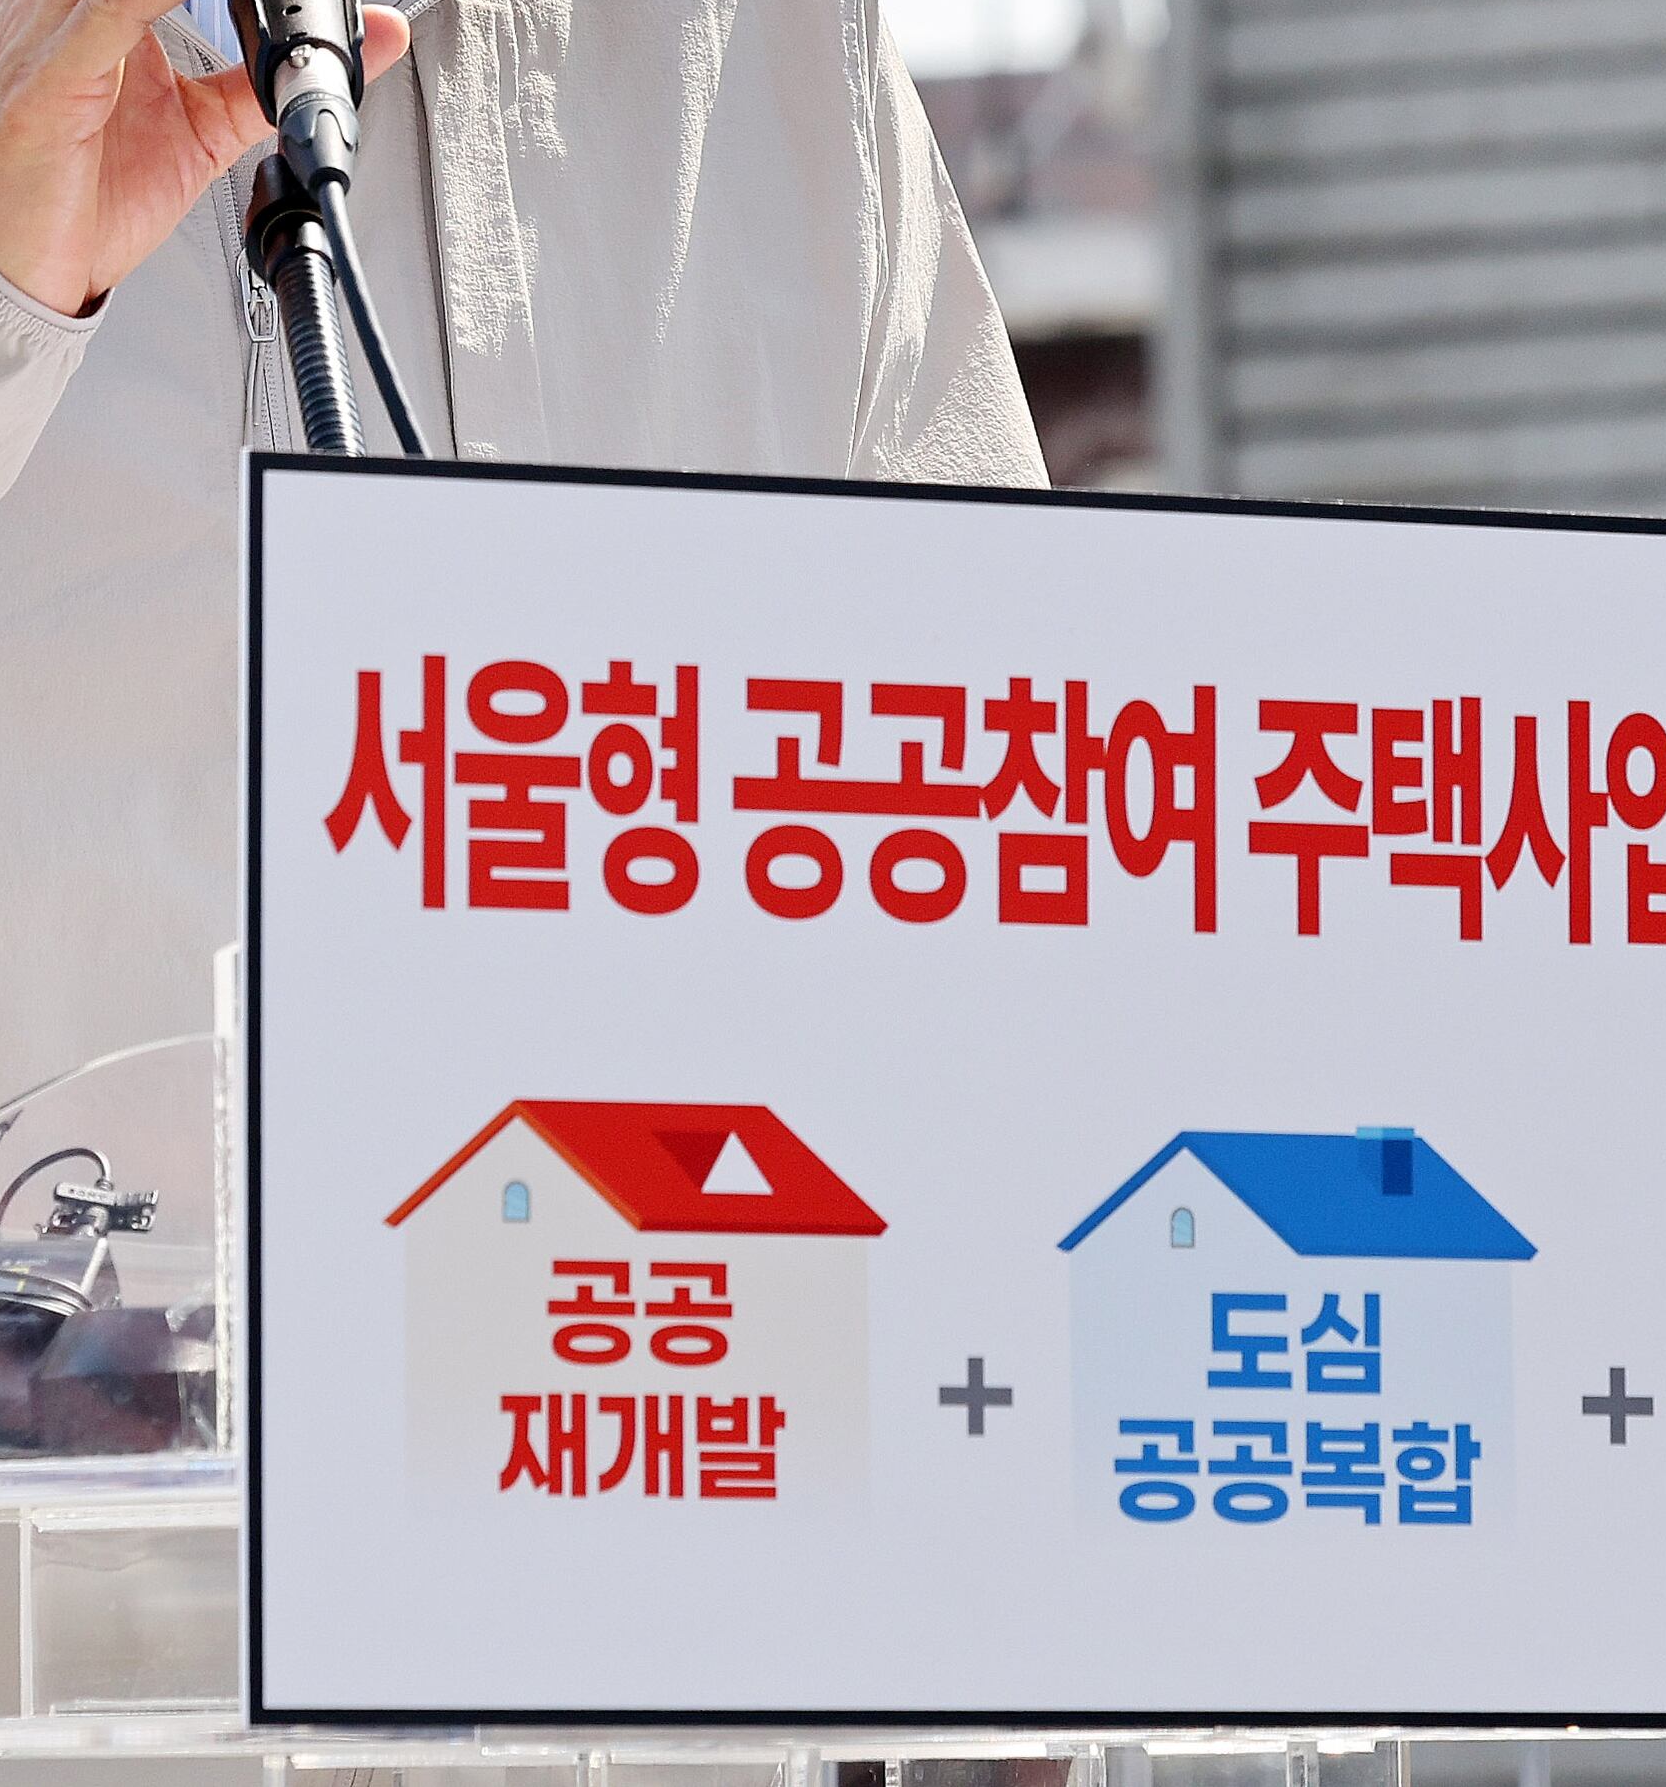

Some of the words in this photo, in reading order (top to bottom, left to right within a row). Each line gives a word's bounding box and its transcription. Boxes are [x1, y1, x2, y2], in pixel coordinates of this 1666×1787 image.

[325, 655, 699, 914] 서울형
[734, 678, 1217, 933] 공공참여
[547, 1260, 733, 1367] 공공
[1207, 1292, 1382, 1395] 도심
[500, 1392, 787, 1500] 재개발
[1114, 1418, 1482, 1526] 공공복합
